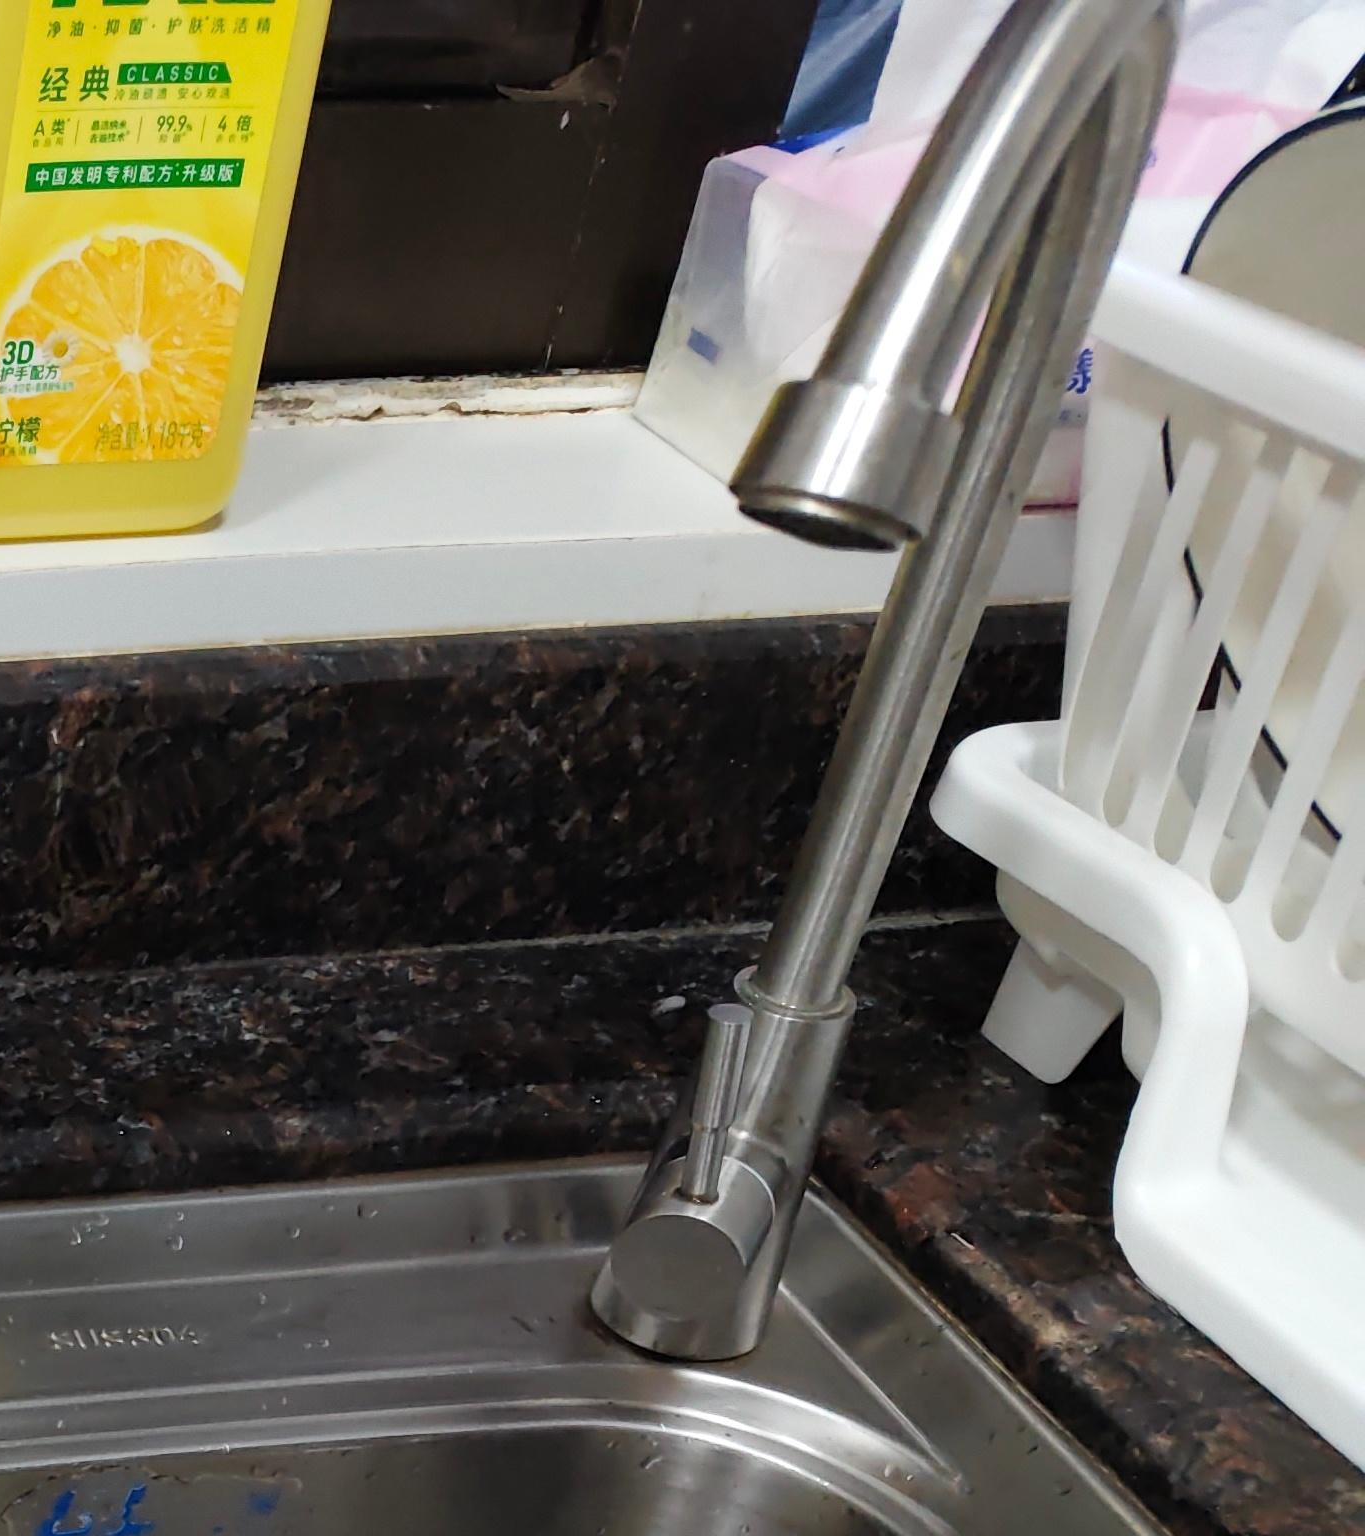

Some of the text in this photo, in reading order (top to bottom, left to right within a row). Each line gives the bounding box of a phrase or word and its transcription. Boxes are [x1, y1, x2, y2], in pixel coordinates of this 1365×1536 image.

[126, 65, 219, 82] CLASSIC
[38, 65, 109, 102] 经典
[218, 114, 253, 132] 4倍
[1, 340, 34, 366] 3D
[0, 364, 60, 383] 护手配方
